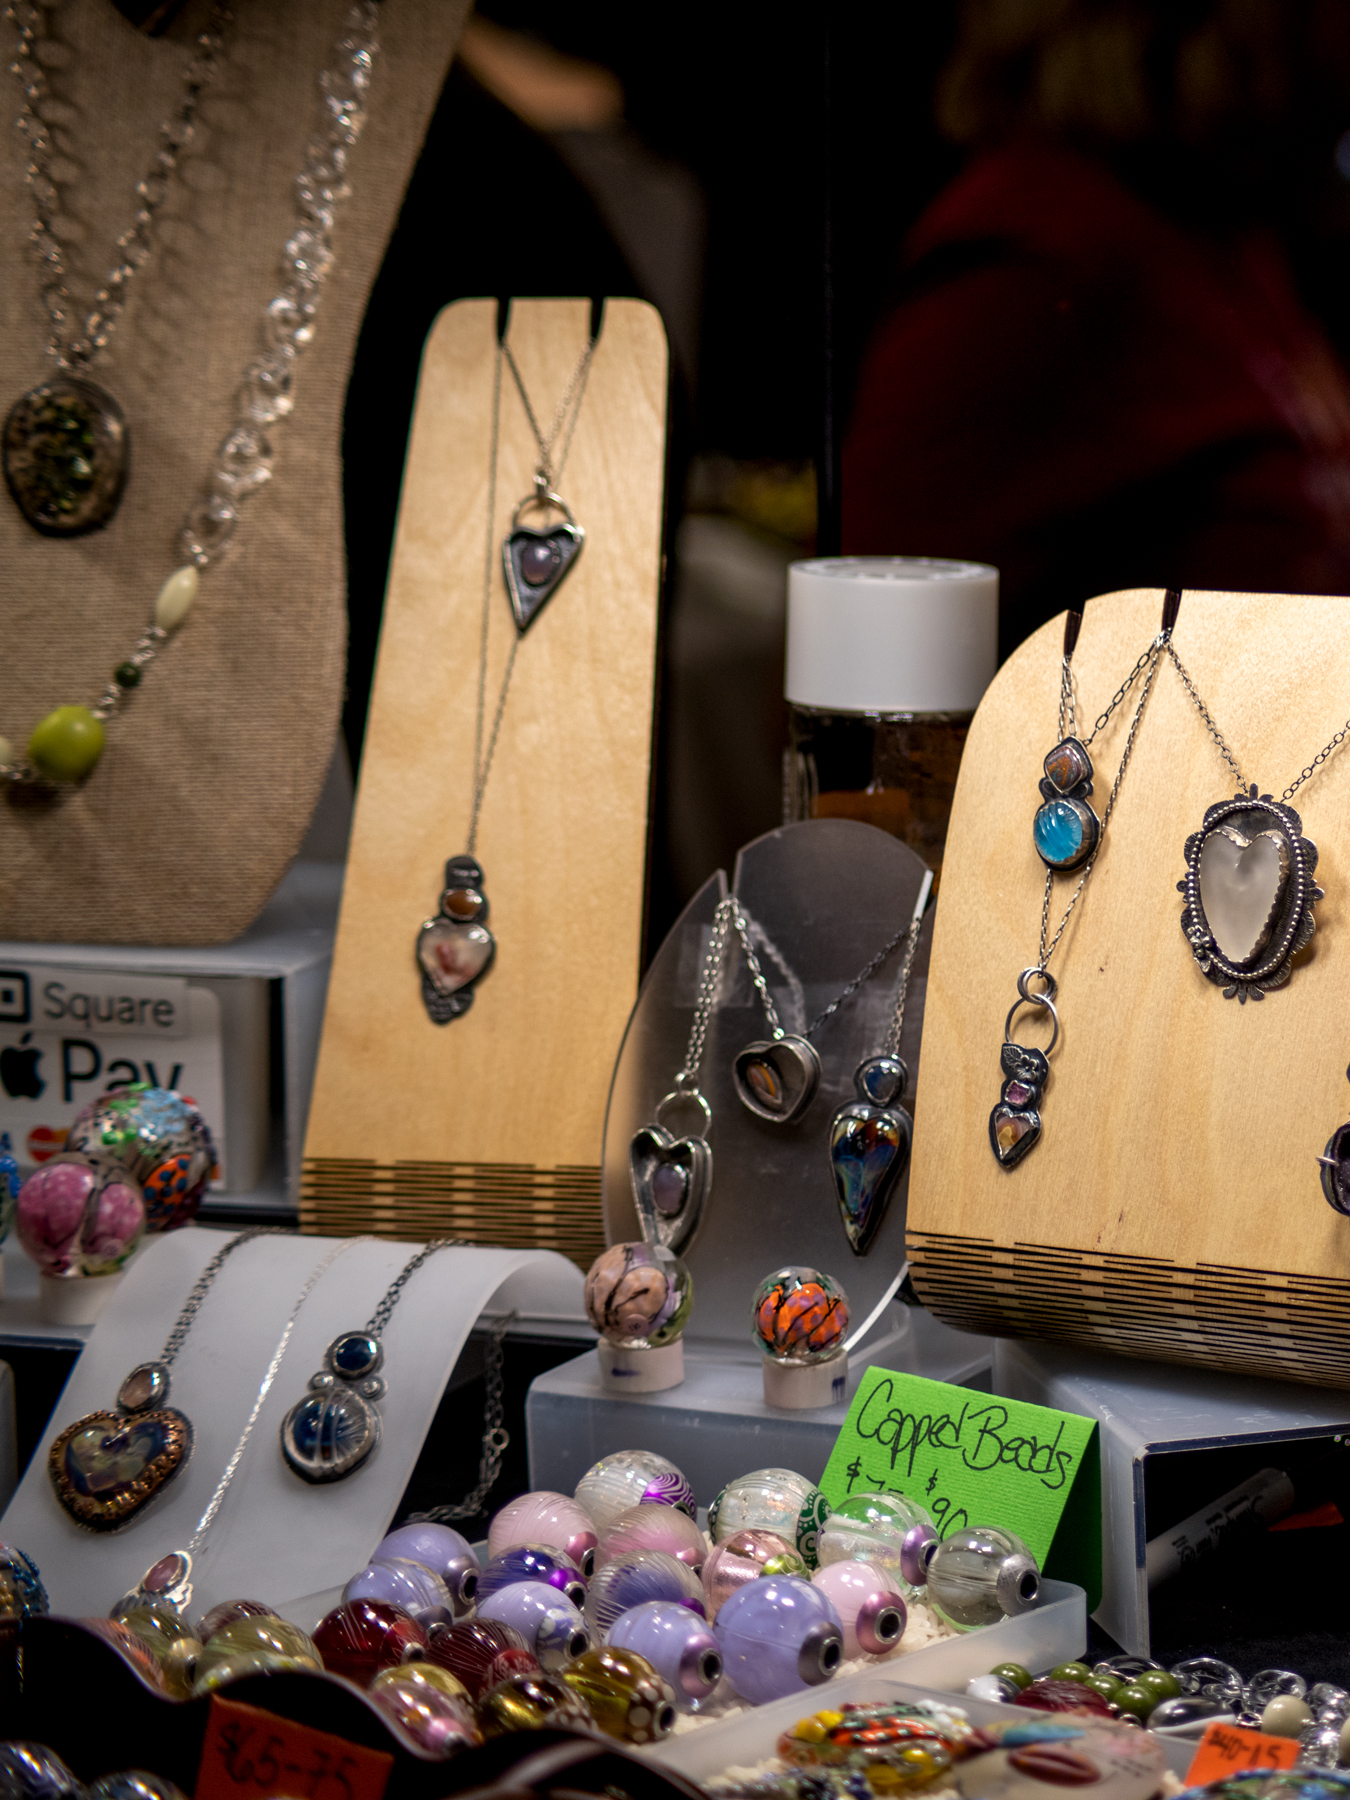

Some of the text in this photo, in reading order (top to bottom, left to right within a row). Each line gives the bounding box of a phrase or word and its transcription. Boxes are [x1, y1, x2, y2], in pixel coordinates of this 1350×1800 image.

[44, 982, 175, 1027] Square
[857, 1379, 1072, 1489] Capped Beads
